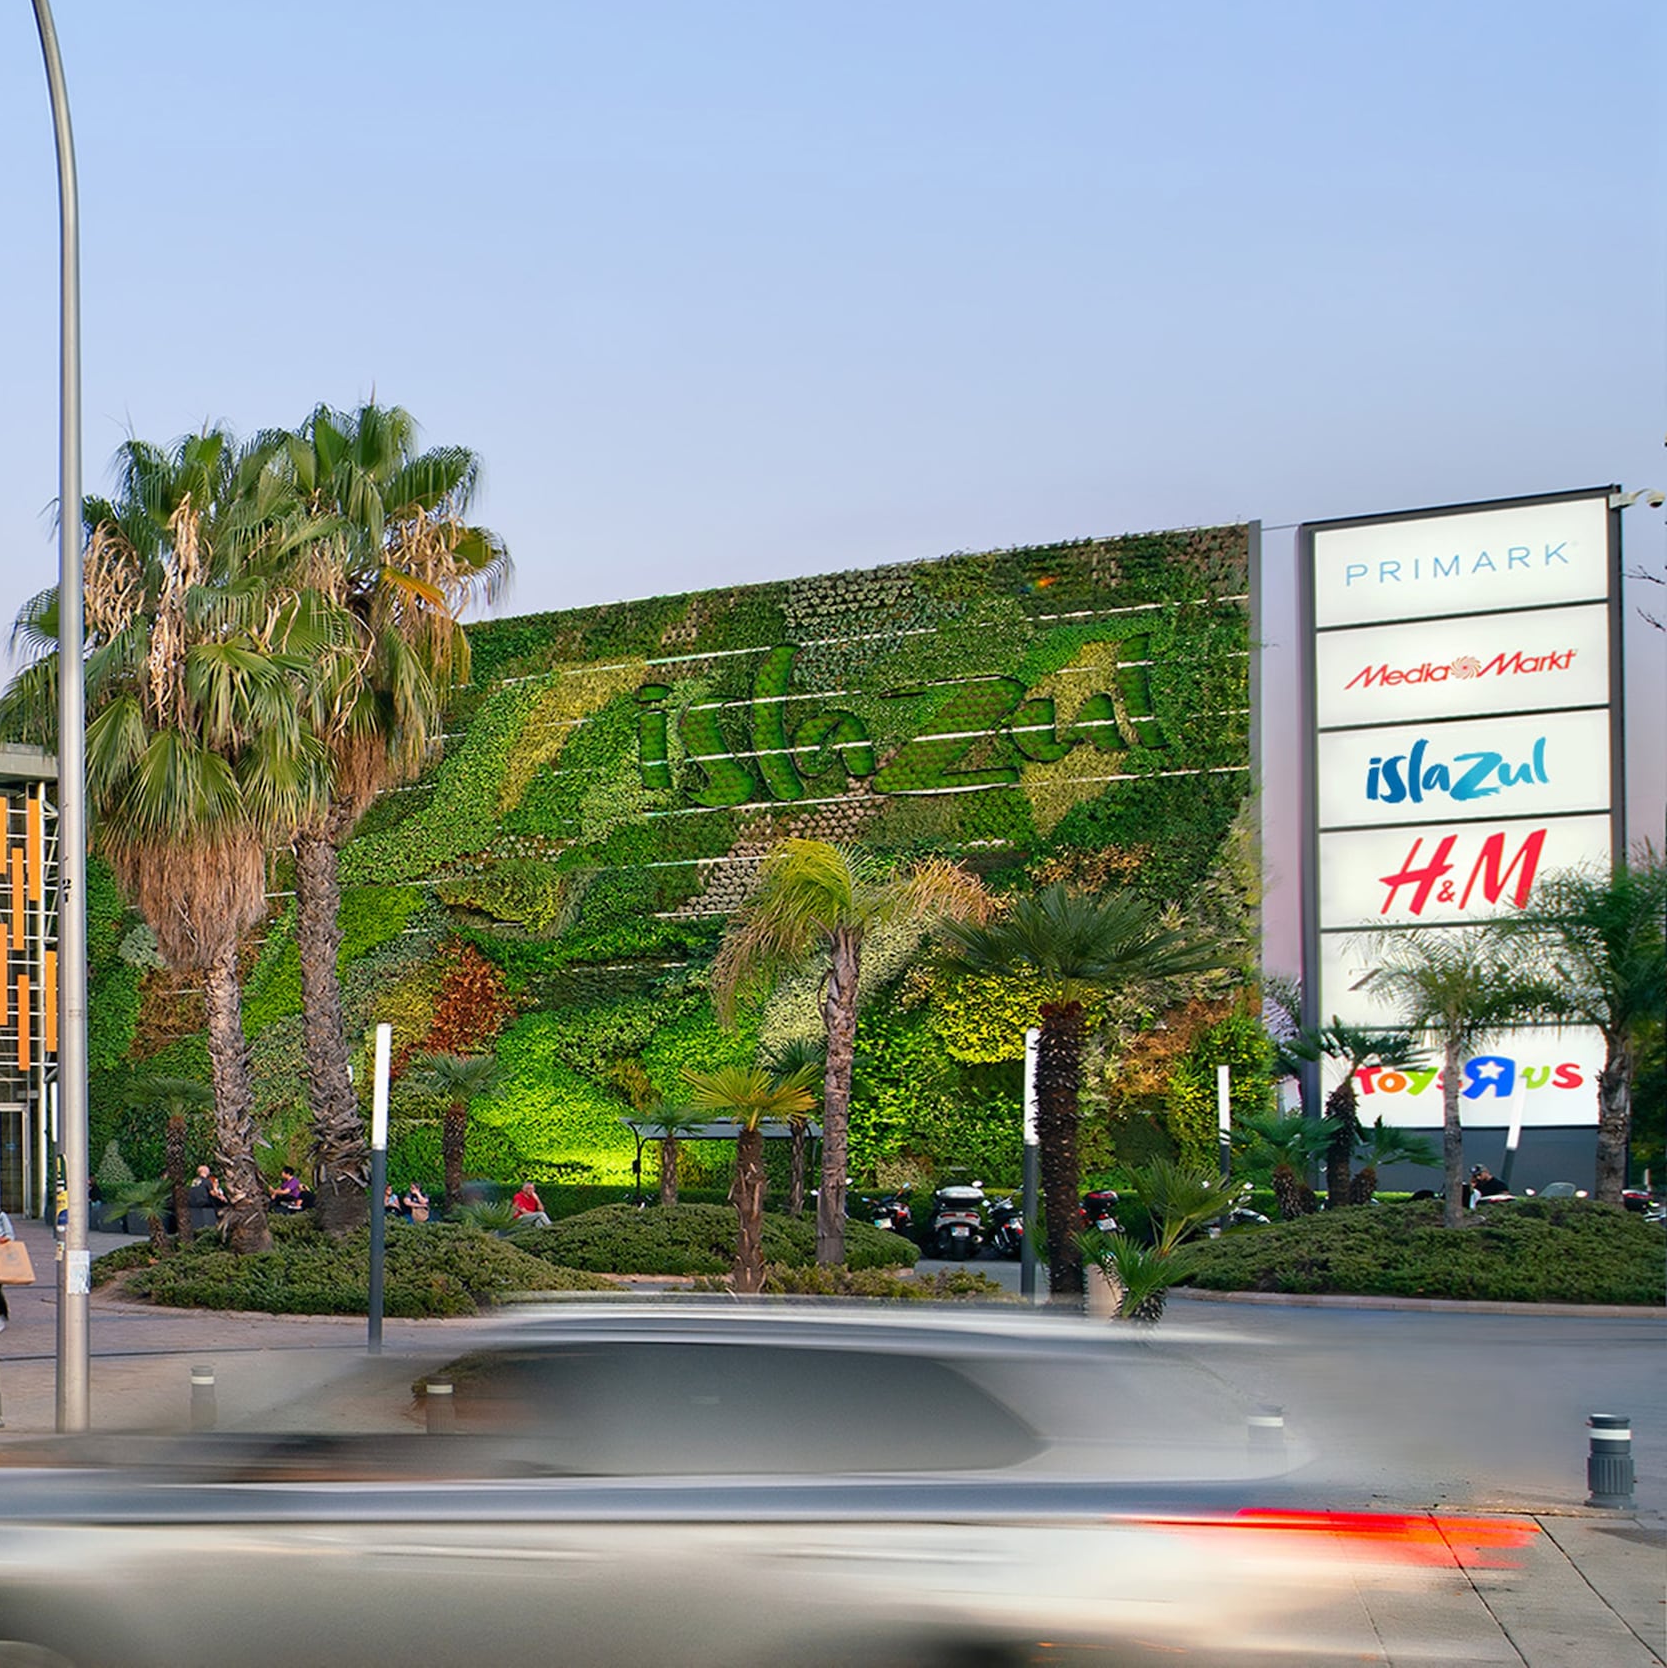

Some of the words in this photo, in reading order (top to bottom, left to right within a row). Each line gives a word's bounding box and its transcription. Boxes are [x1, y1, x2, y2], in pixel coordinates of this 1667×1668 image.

[1346, 541, 1569, 586] PRIMARK
[1344, 663, 1450, 690] Media
[1476, 649, 1576, 678] Markt
[1379, 828, 1547, 916] H&M
